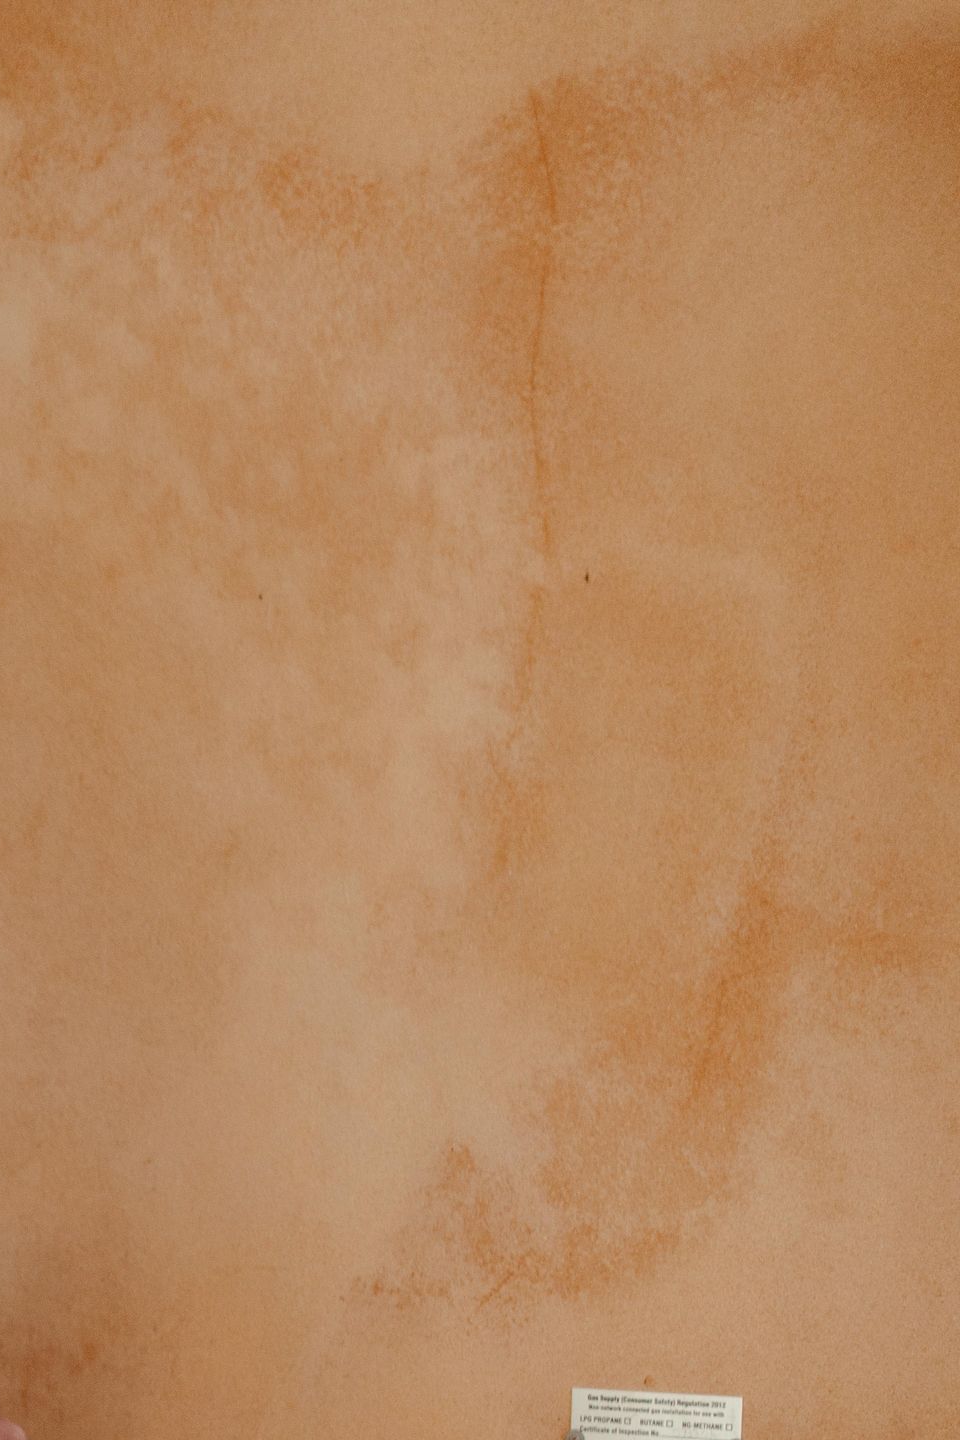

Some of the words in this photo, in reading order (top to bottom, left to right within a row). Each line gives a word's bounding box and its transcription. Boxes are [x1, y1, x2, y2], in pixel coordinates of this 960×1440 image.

[600, 1394, 620, 1403] Supply
[621, 1395, 652, 1404] (Consumer
[654, 1397, 676, 1407] Safety)
[676, 1399, 710, 1408] Regulation
[593, 1416, 622, 1424] PROPANE
[639, 1418, 664, 1426] BUTANE
[693, 1422, 723, 1430] METHANE
[579, 1425, 609, 1433] Certificate
[618, 1428, 650, 1436] Inspection
